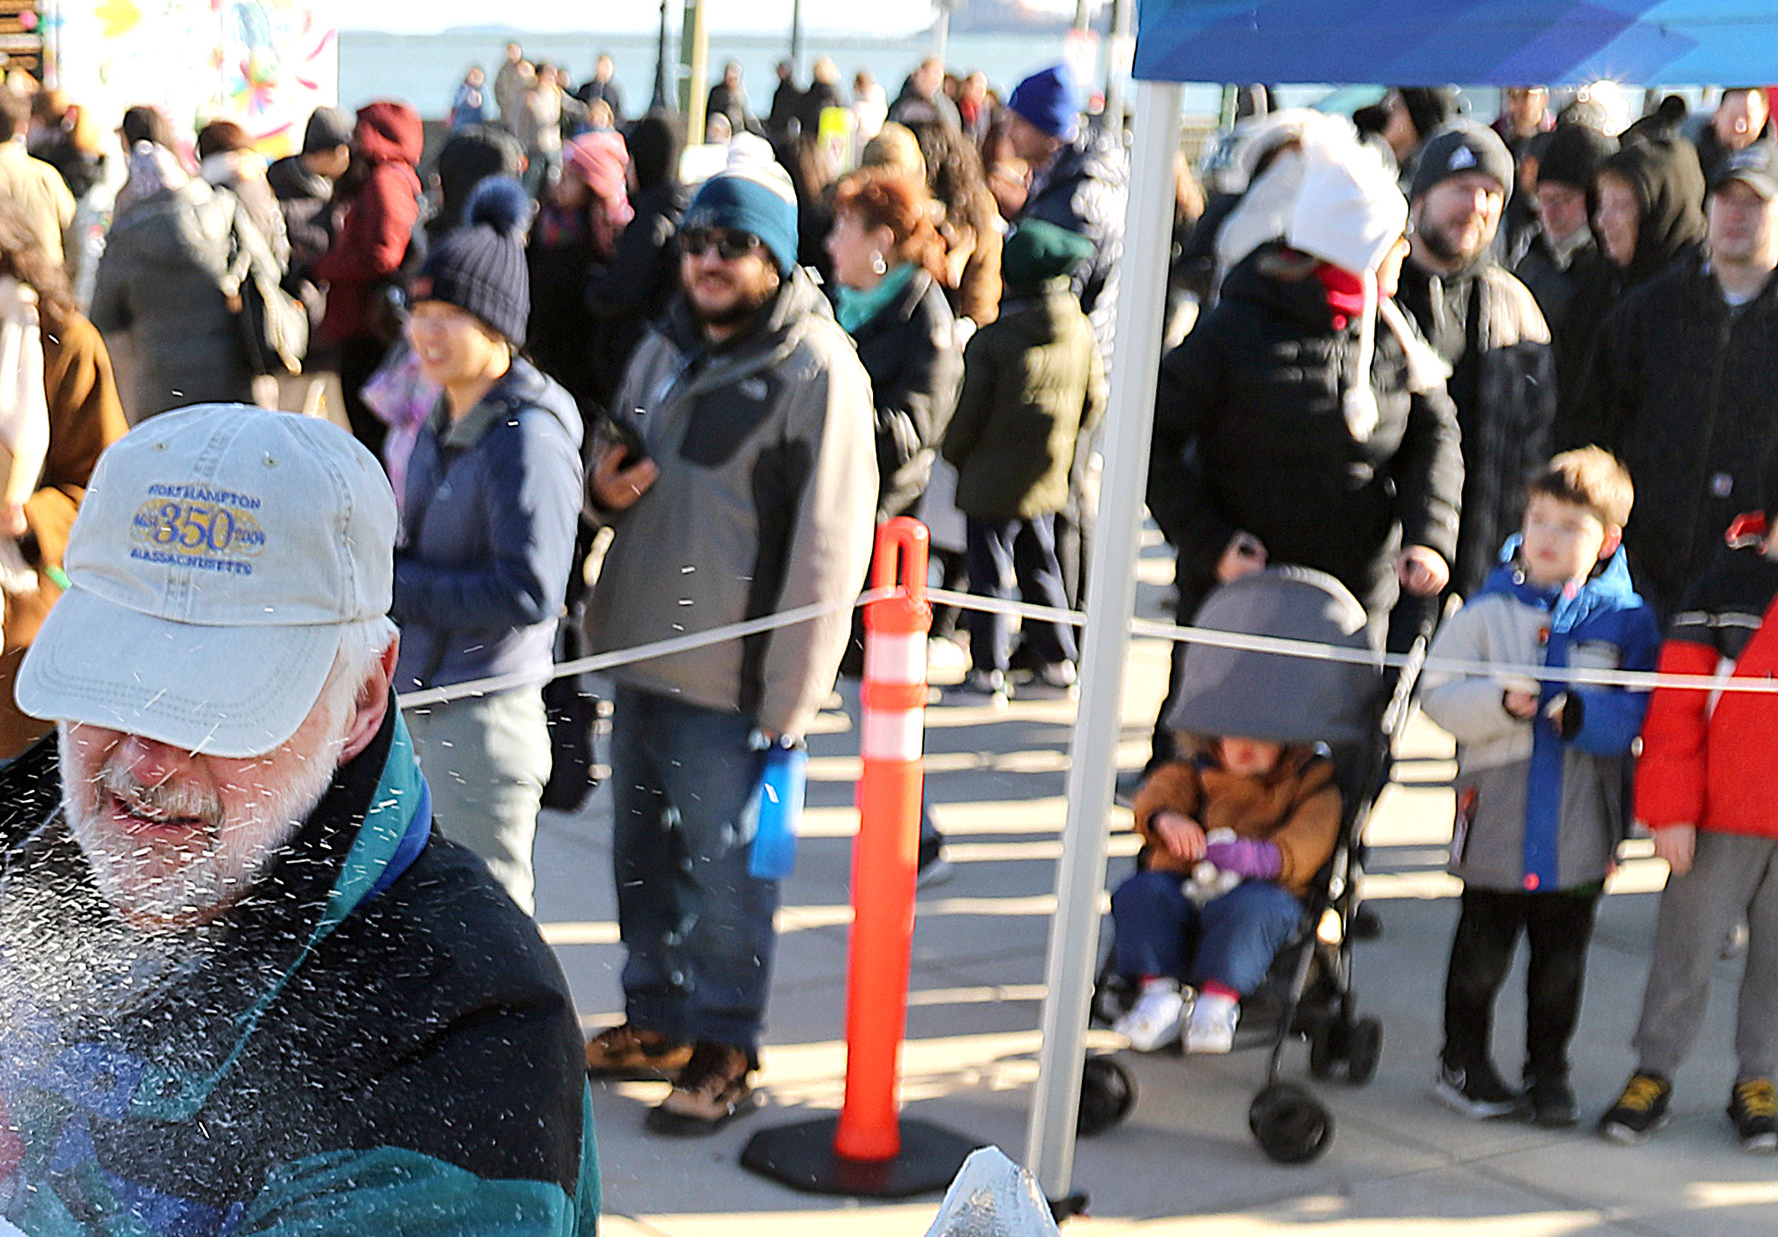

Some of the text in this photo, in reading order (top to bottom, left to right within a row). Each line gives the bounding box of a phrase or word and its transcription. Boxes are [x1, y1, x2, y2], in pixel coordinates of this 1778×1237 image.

[147, 482, 262, 510] NORTHAMPTON
[153, 503, 235, 551] 350
[130, 547, 253, 576] MASSACHUSETTS
